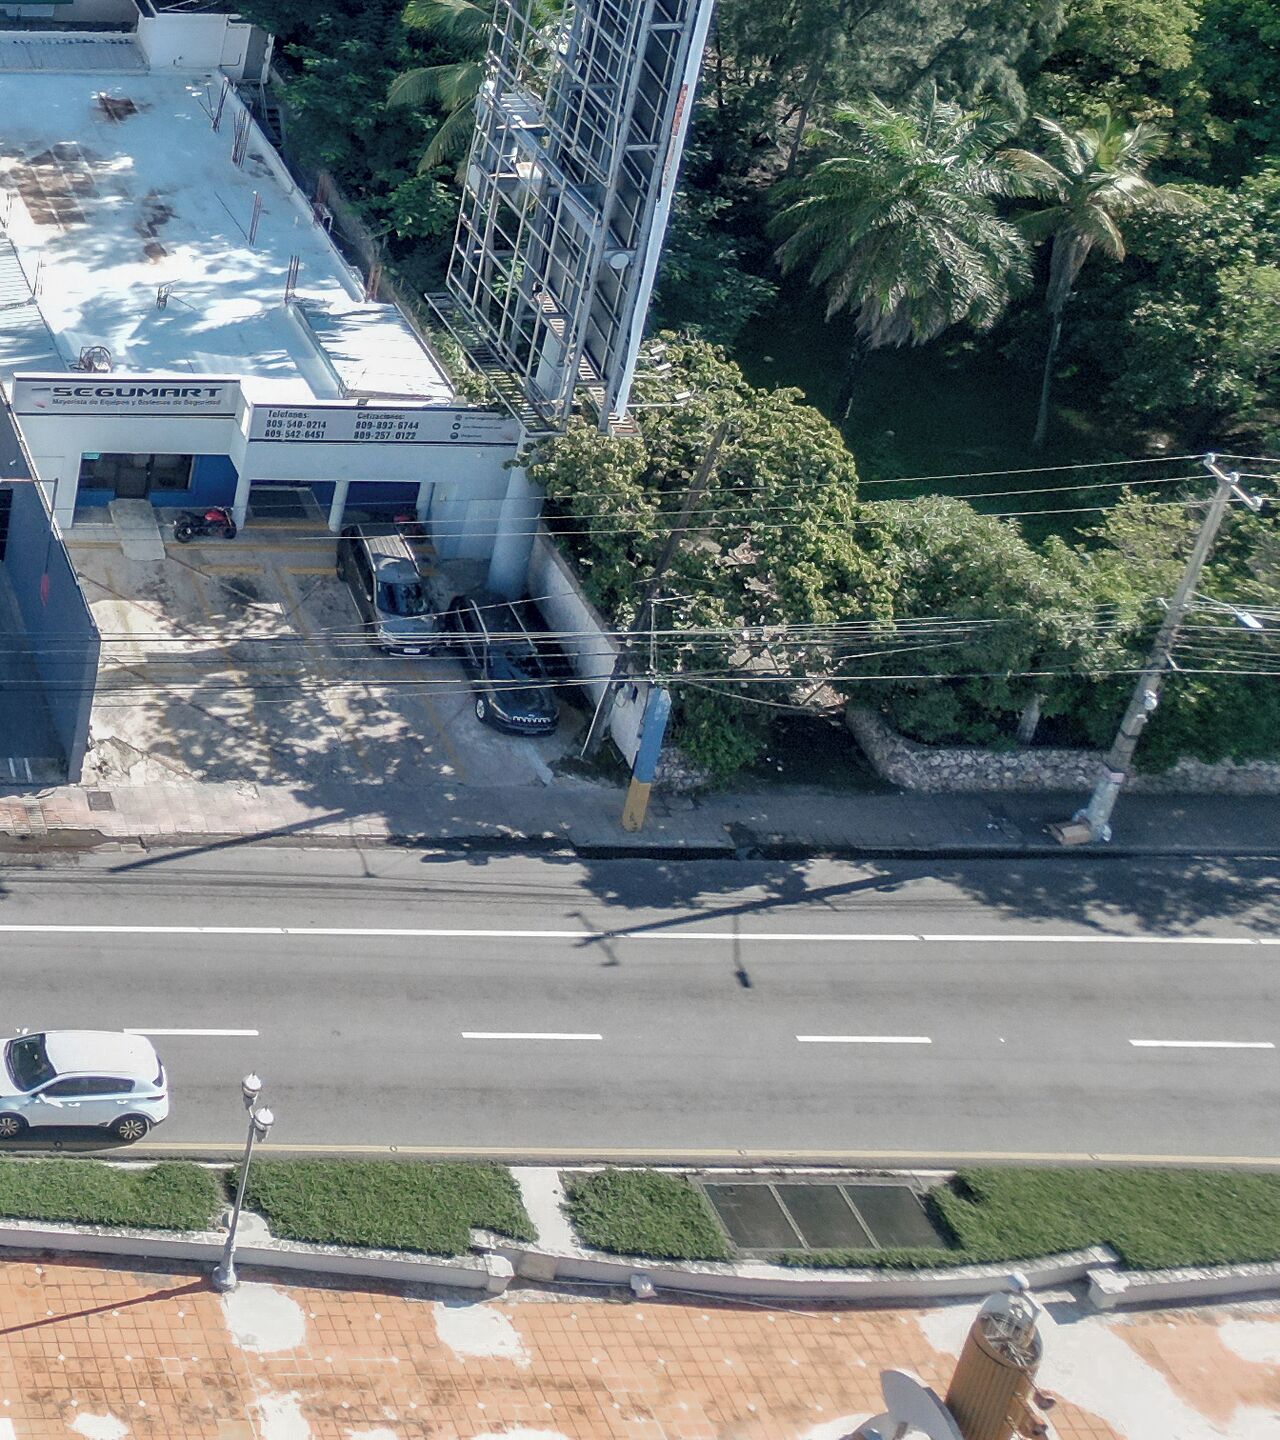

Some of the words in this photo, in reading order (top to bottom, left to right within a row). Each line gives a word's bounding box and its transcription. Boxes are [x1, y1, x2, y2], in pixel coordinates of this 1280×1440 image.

[52, 386, 223, 398] SEGUMART
[52, 398, 87, 406] Mayorista
[266, 419, 327, 429] 809-540-0214
[355, 421, 419, 430] 809-893-6744
[264, 429, 325, 439] 809-542-6451
[354, 431, 417, 440] 809-257-0122
